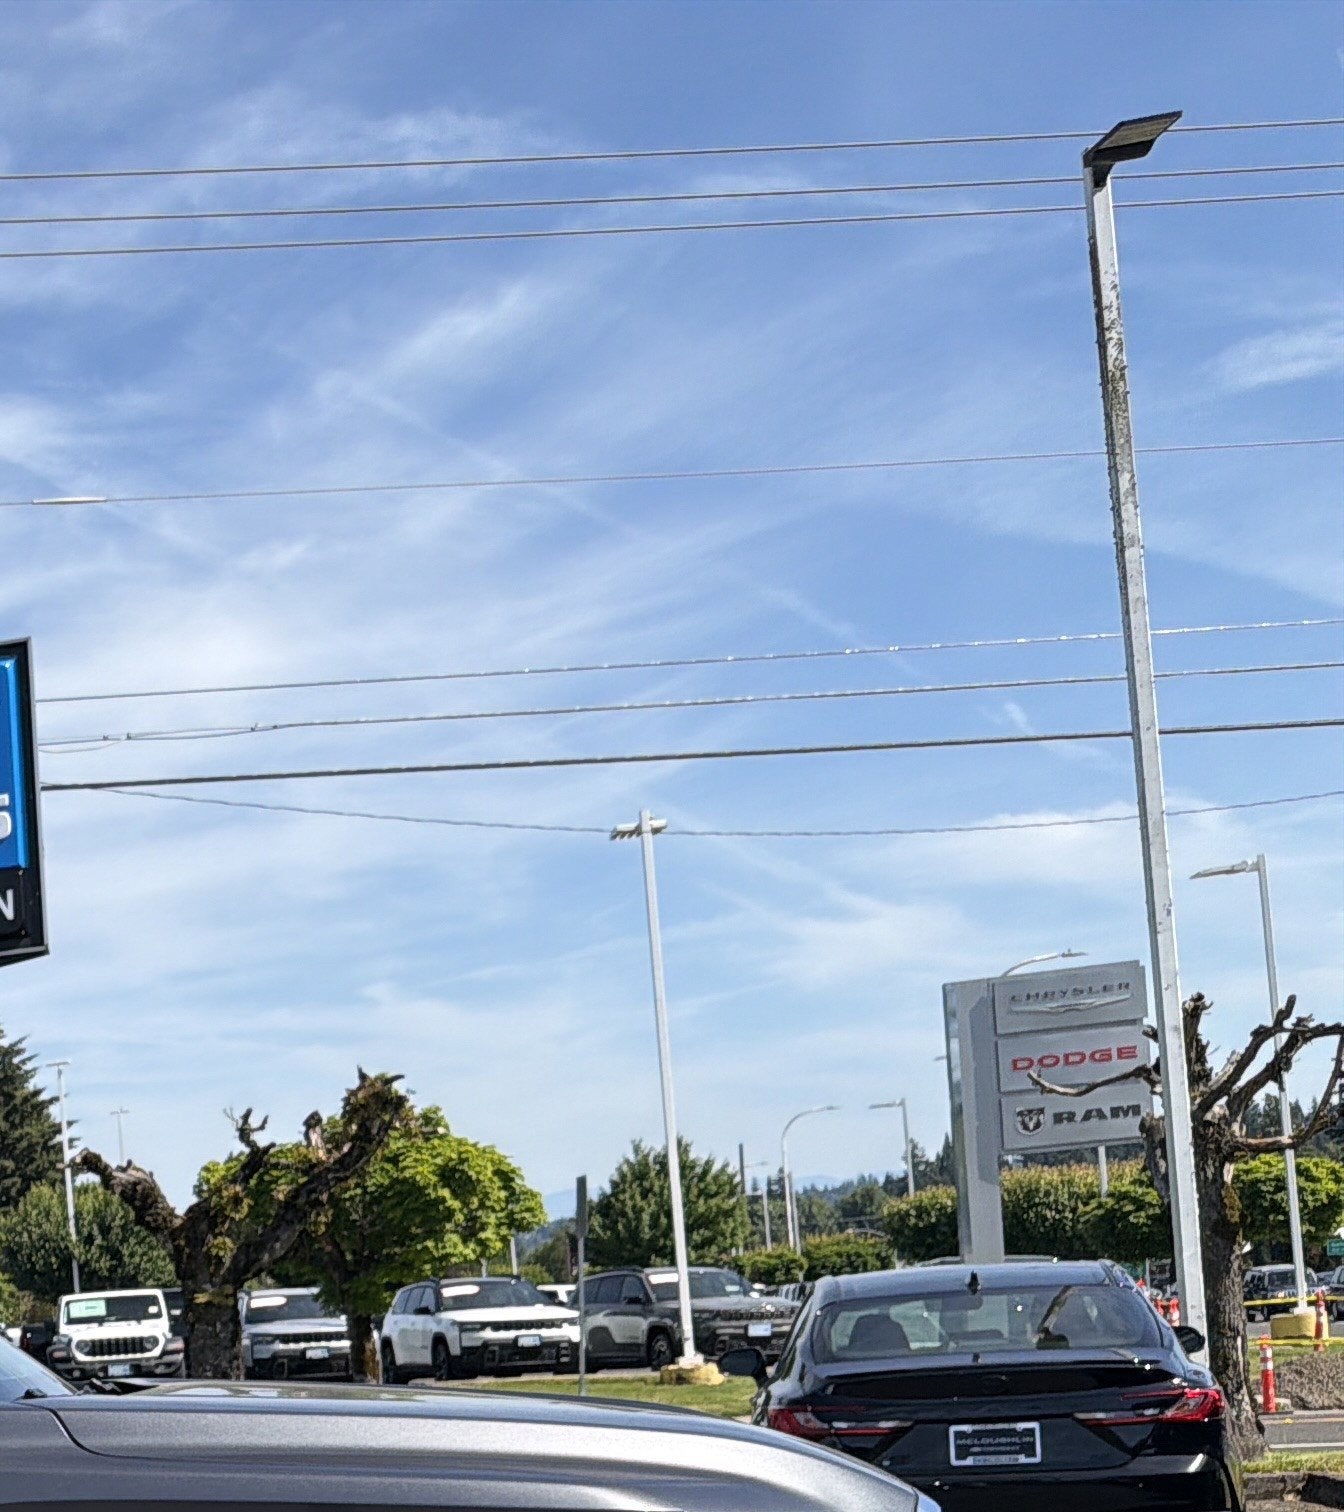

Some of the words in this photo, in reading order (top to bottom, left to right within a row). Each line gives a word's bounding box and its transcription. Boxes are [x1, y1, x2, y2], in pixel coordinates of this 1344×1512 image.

[1010, 982, 1131, 1002] CHRYSLER
[1011, 1045, 1138, 1071] DODGE
[1052, 1103, 1141, 1125] RAM
